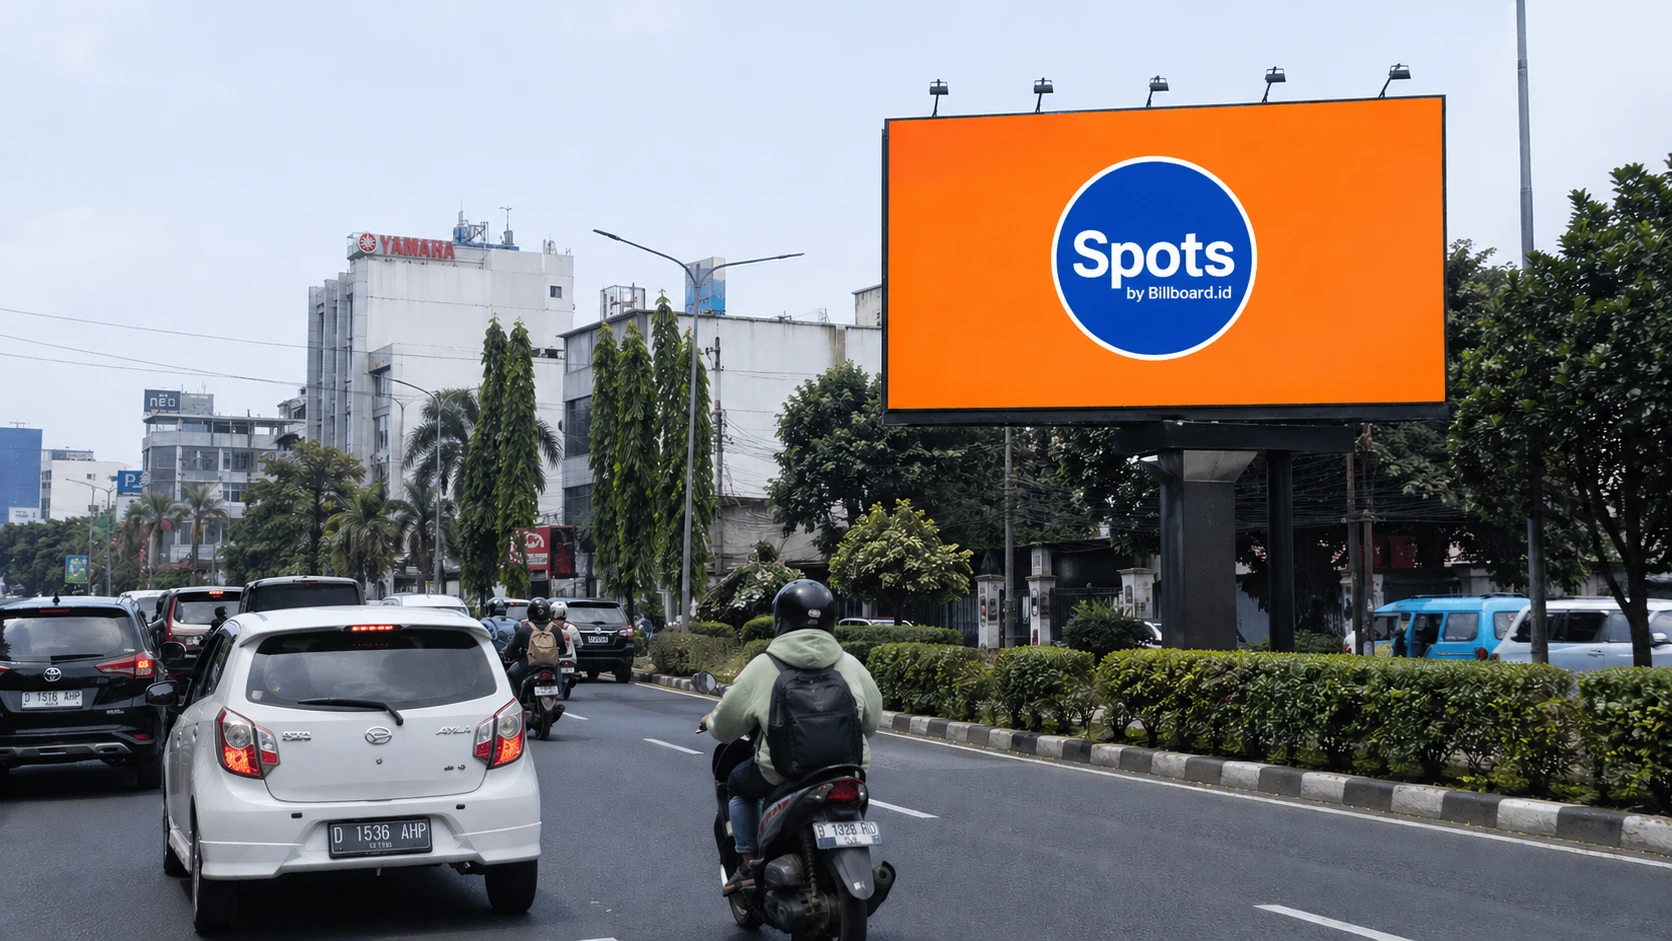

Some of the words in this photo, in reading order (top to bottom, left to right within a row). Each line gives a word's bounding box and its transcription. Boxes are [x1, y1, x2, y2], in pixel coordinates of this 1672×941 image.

[380, 234, 456, 259] YAMAHA
[1073, 229, 1235, 289] Spots
[1126, 286, 1145, 302] by
[1149, 286, 1232, 299] Billboard.id
[24, 692, 31, 703] D
[63, 691, 81, 701] AHP
[333, 826, 343, 844] D
[356, 824, 390, 841] 1536
[401, 822, 426, 839] AHP
